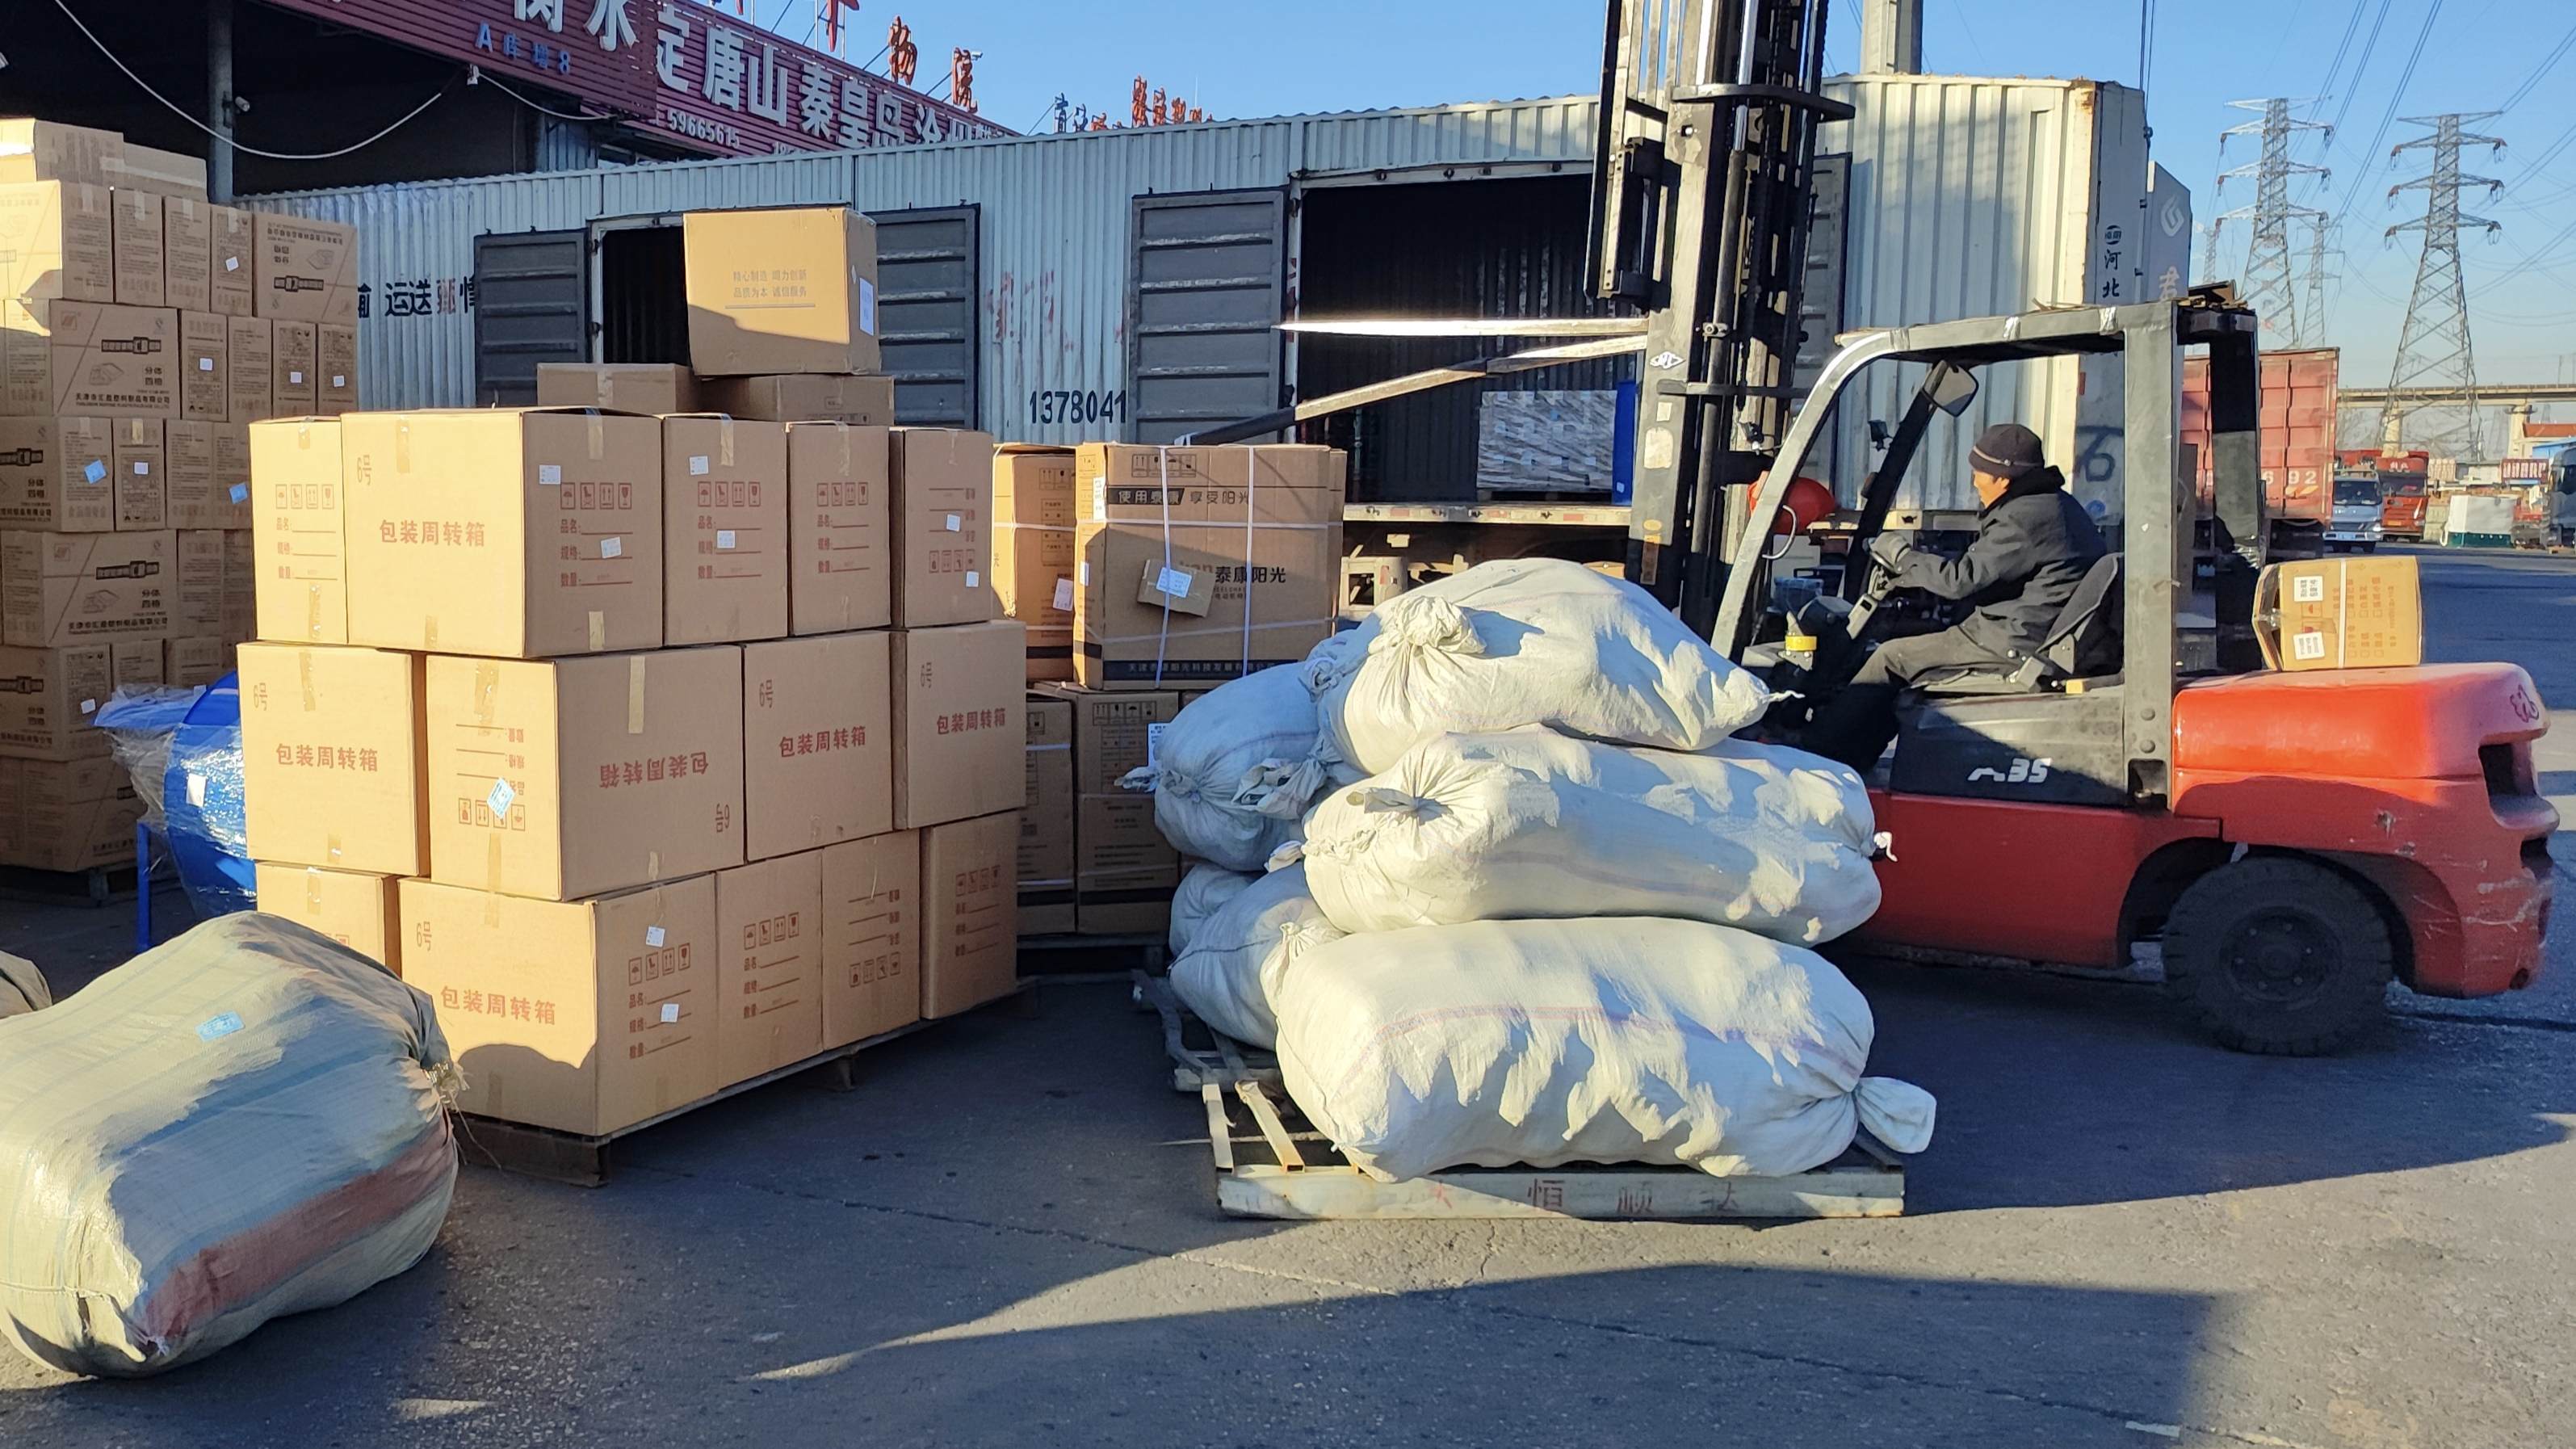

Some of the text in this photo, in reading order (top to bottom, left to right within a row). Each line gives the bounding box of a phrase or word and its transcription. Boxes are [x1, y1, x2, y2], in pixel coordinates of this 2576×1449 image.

[2101, 249, 2122, 299] 河北
[1030, 390, 1126, 424] 1378041
[1118, 489, 1180, 504] 使用泰康
[380, 519, 486, 548] 包装周转箱
[1215, 566, 1286, 584] 泰康阳光
[936, 708, 1006, 735] 包装周转箱
[275, 742, 379, 772] 包装周转箱
[778, 725, 866, 758] 包装周转箱
[600, 751, 709, 789] 包装周转箱
[440, 985, 556, 1026] 包装周转箱
